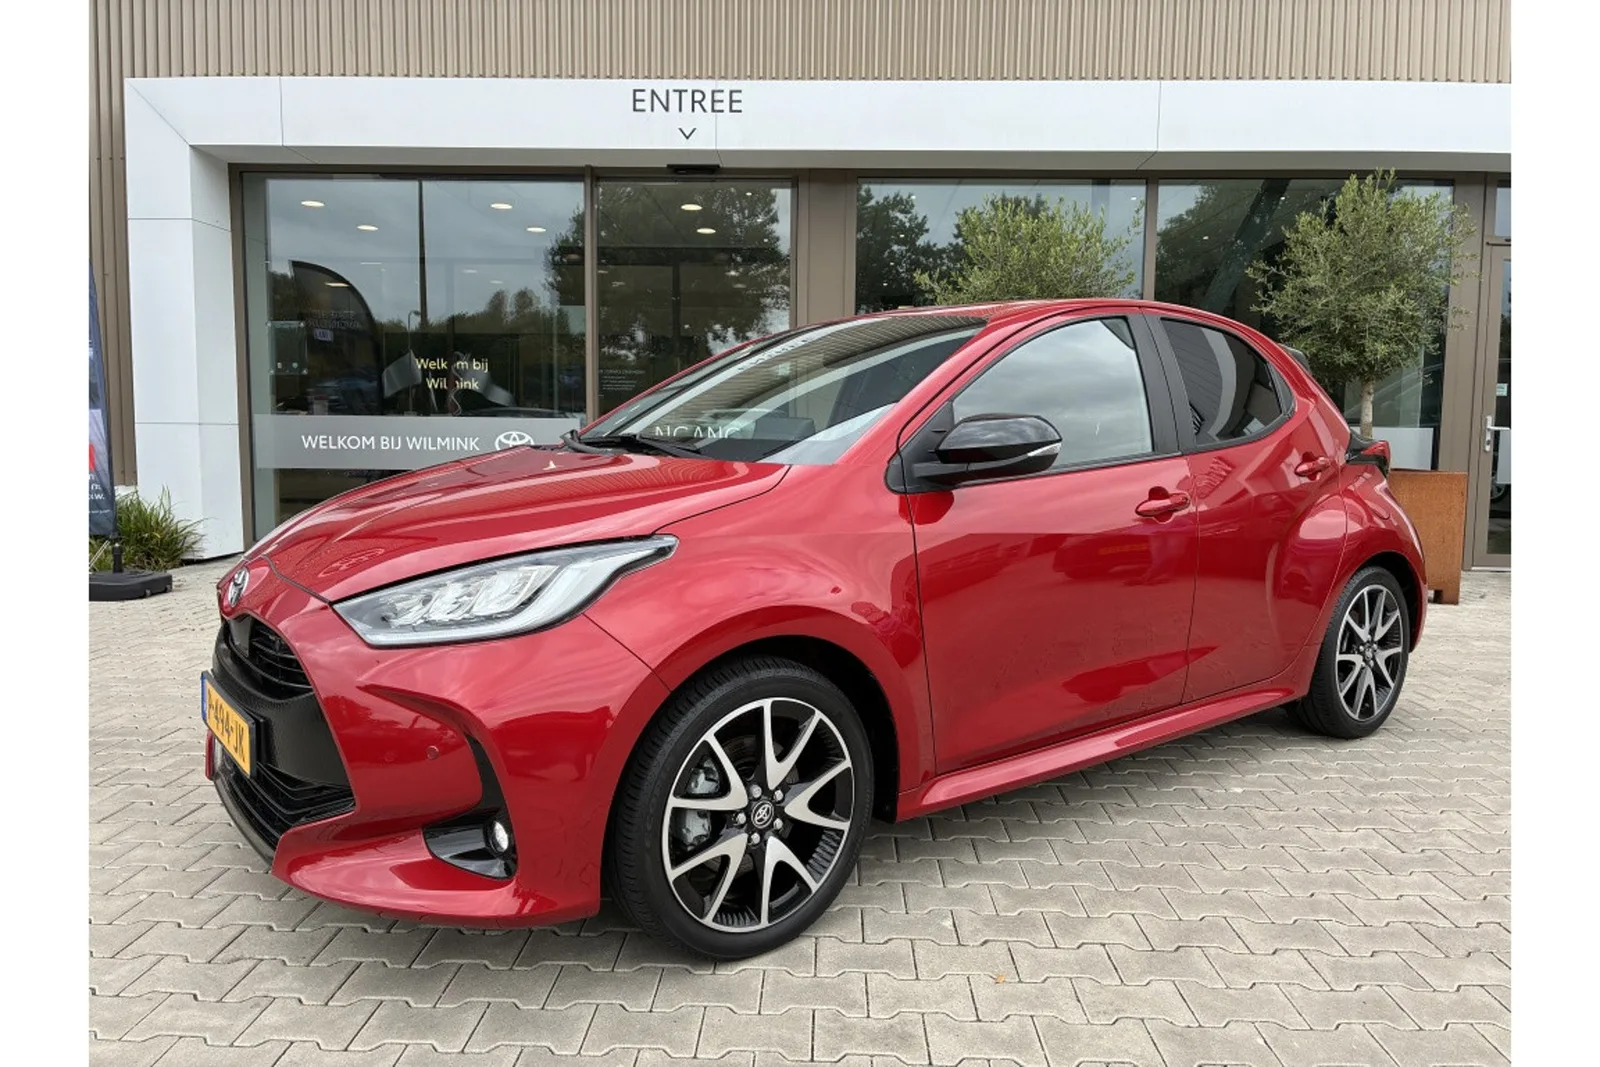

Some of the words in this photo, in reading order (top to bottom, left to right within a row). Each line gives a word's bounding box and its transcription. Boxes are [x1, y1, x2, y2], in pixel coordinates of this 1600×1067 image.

[632, 89, 743, 113] ENTREE
[415, 357, 468, 370] Welkm
[472, 358, 489, 373] bij
[301, 435, 375, 450] WELKOM
[380, 436, 401, 450] BIJ
[406, 436, 480, 451] WILMINK
